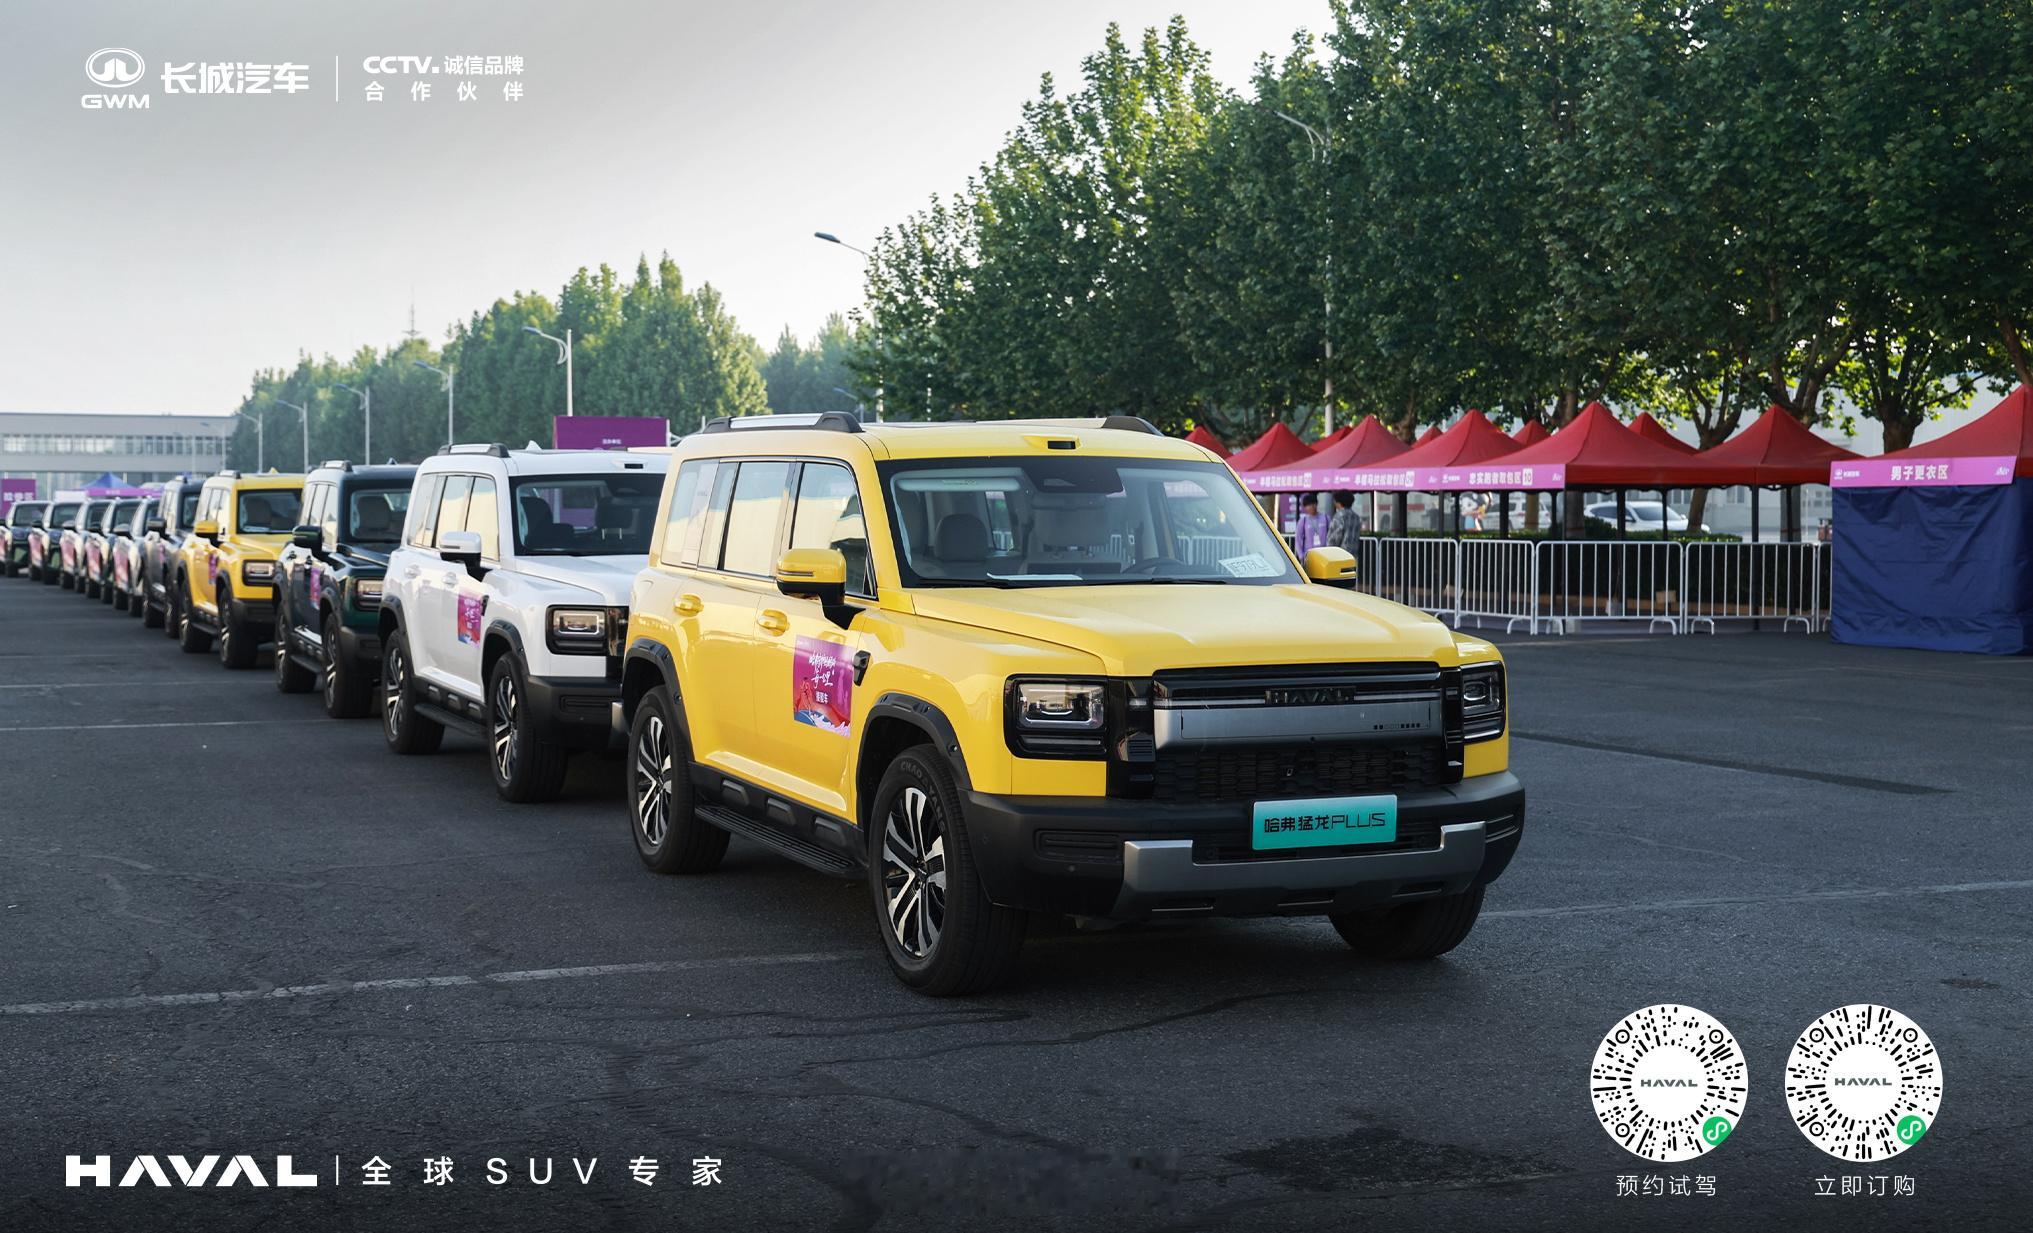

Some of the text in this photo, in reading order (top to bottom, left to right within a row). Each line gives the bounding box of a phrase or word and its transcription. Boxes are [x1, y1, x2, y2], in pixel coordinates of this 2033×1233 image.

[1891, 464, 1949, 481] 男子更衣区
